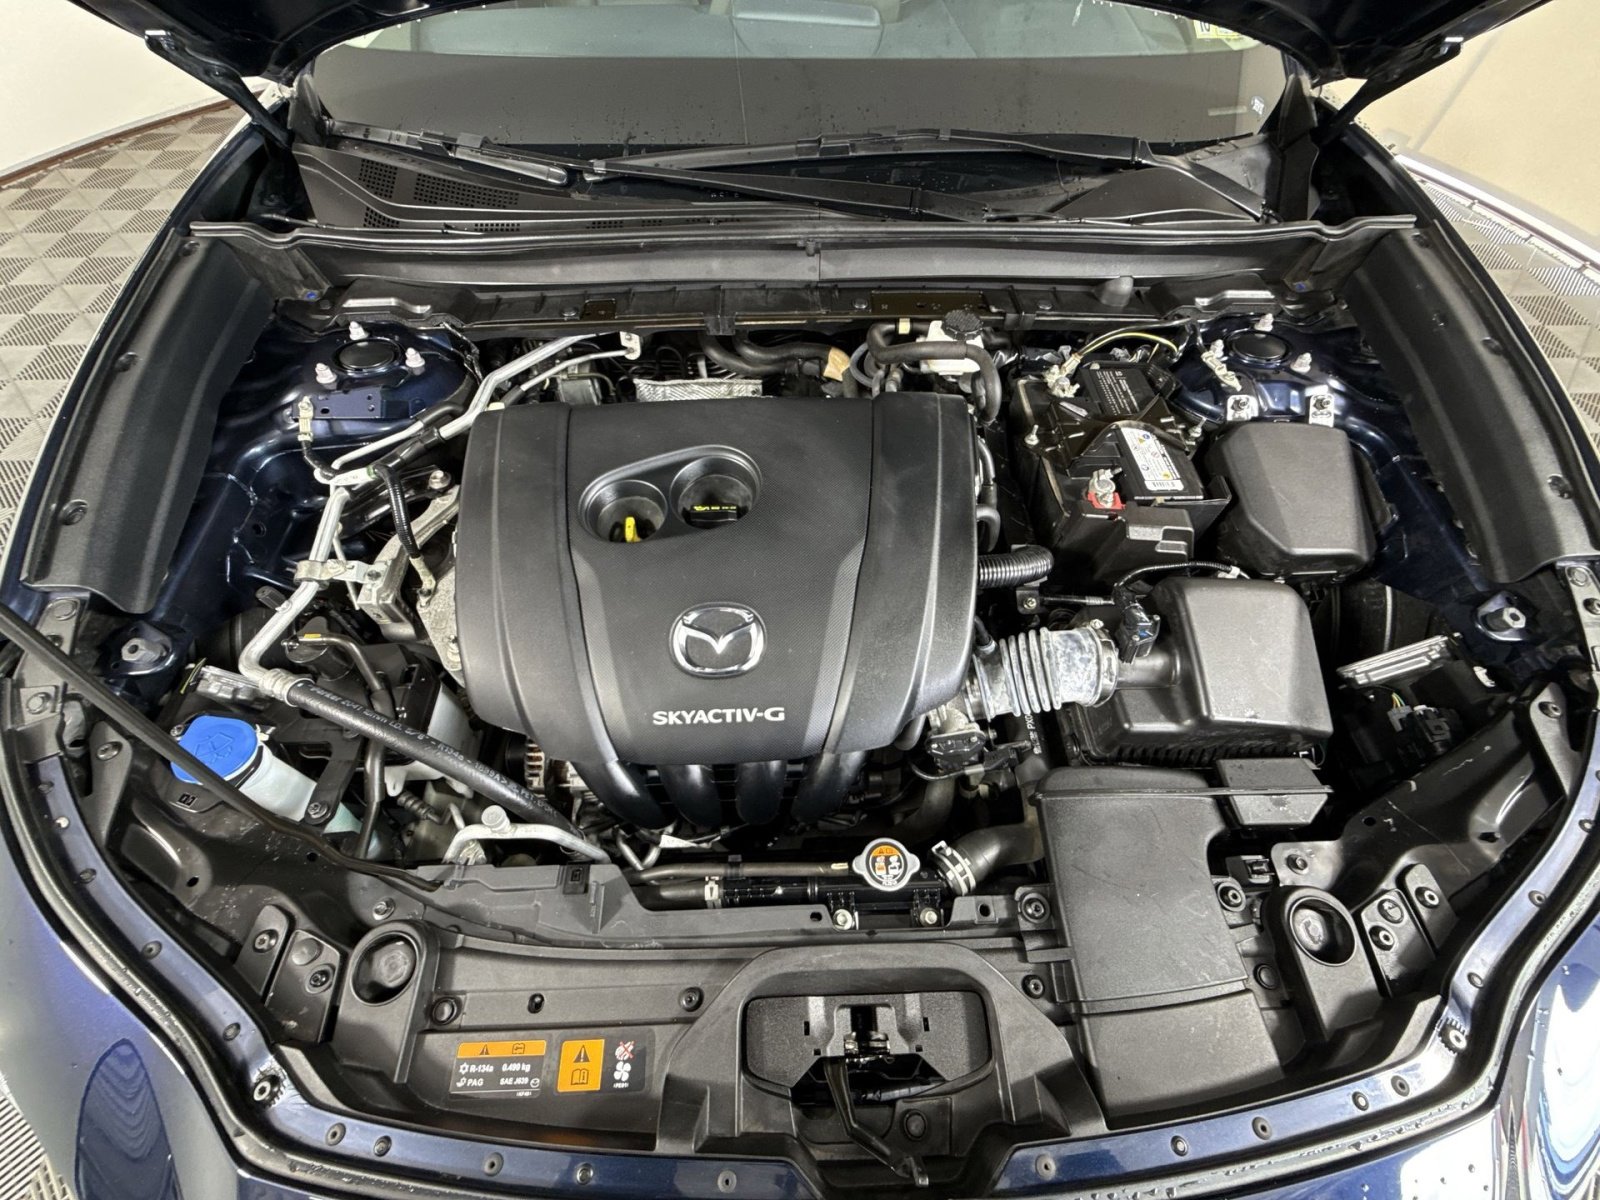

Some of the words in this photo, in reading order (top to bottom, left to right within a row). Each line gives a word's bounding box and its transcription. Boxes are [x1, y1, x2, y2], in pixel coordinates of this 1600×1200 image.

[652, 706, 786, 726] SKYACTIV-G
[469, 1063, 494, 1073] R-134a
[521, 1062, 531, 1073] kg
[466, 1077, 484, 1086] PAG
[499, 1077, 512, 1085] SAE
